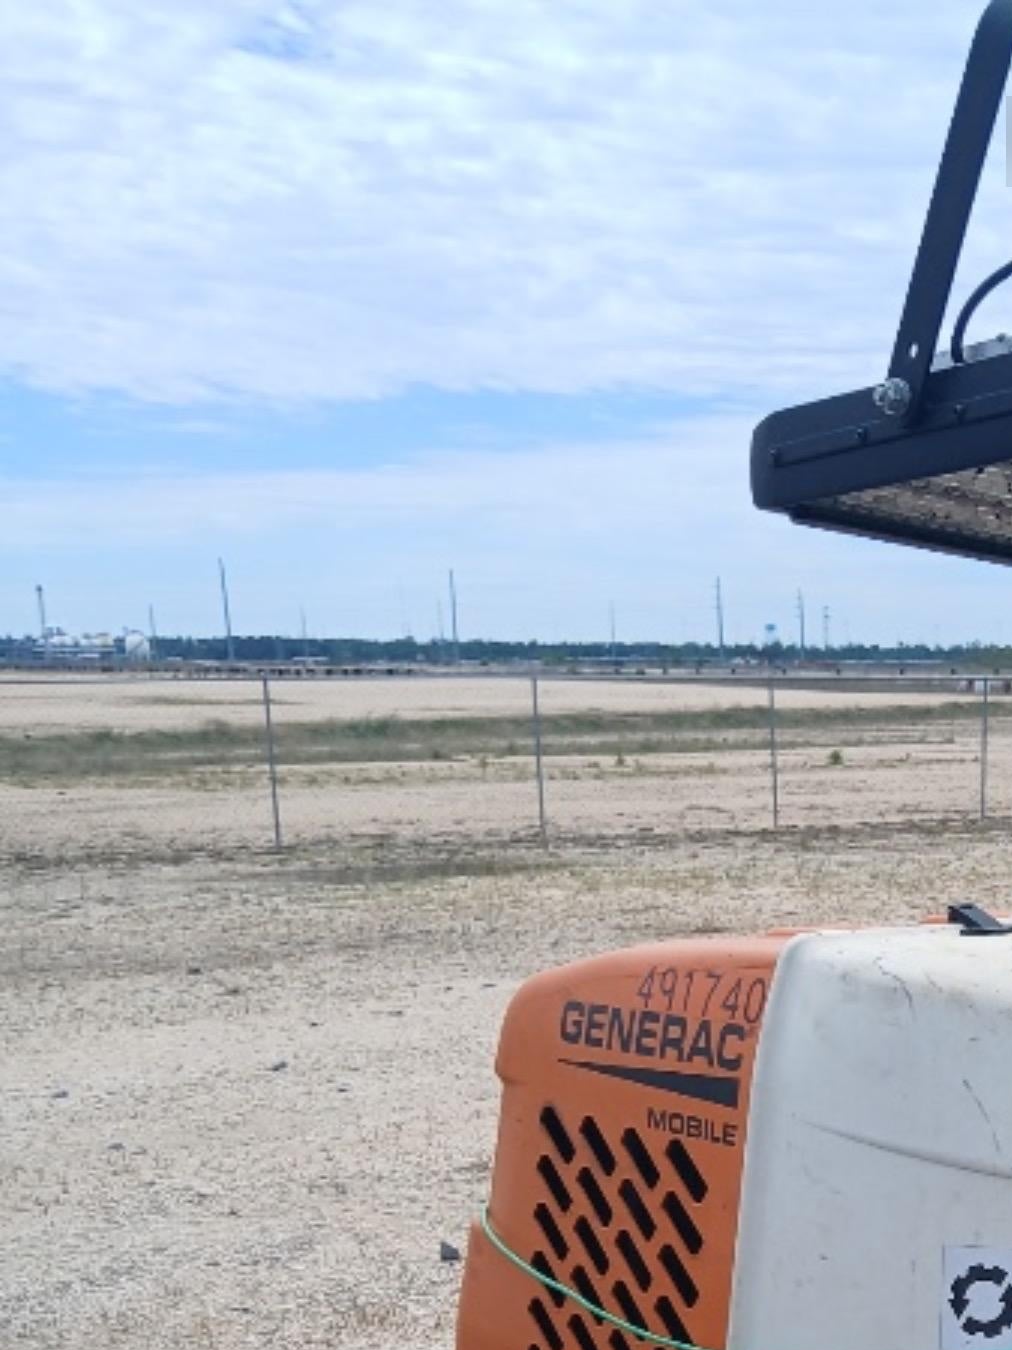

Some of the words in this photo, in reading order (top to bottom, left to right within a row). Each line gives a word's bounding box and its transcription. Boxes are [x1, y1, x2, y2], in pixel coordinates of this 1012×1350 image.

[637, 966, 767, 1024] 491740
[560, 999, 747, 1072] GENERAC
[646, 1107, 738, 1146] MOBILE
